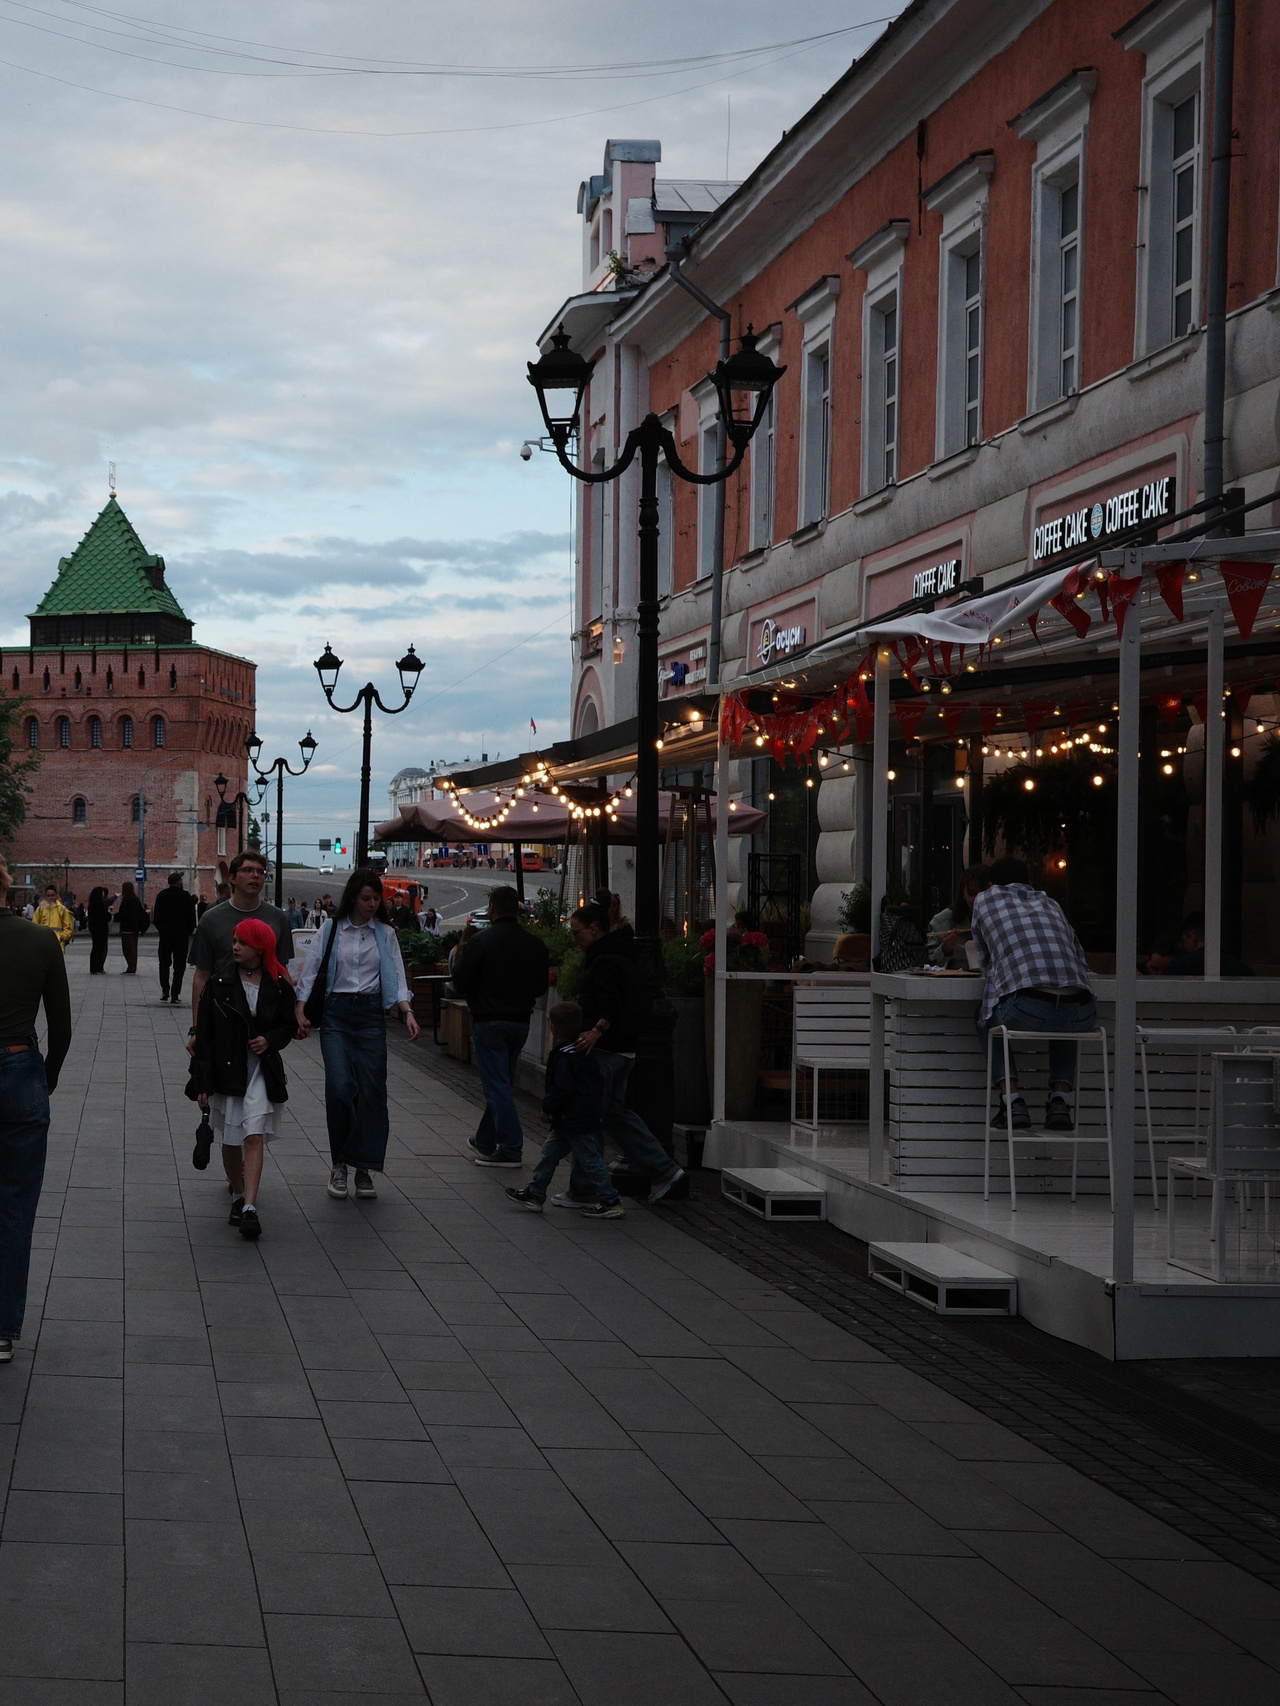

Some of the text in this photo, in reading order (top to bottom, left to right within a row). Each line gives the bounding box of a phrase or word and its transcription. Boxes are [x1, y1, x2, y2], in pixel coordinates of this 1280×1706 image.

[1033, 477, 1169, 561] COFFEE CAKE COFFEE CAKE
[913, 559, 957, 599] COFFEE CAKE
